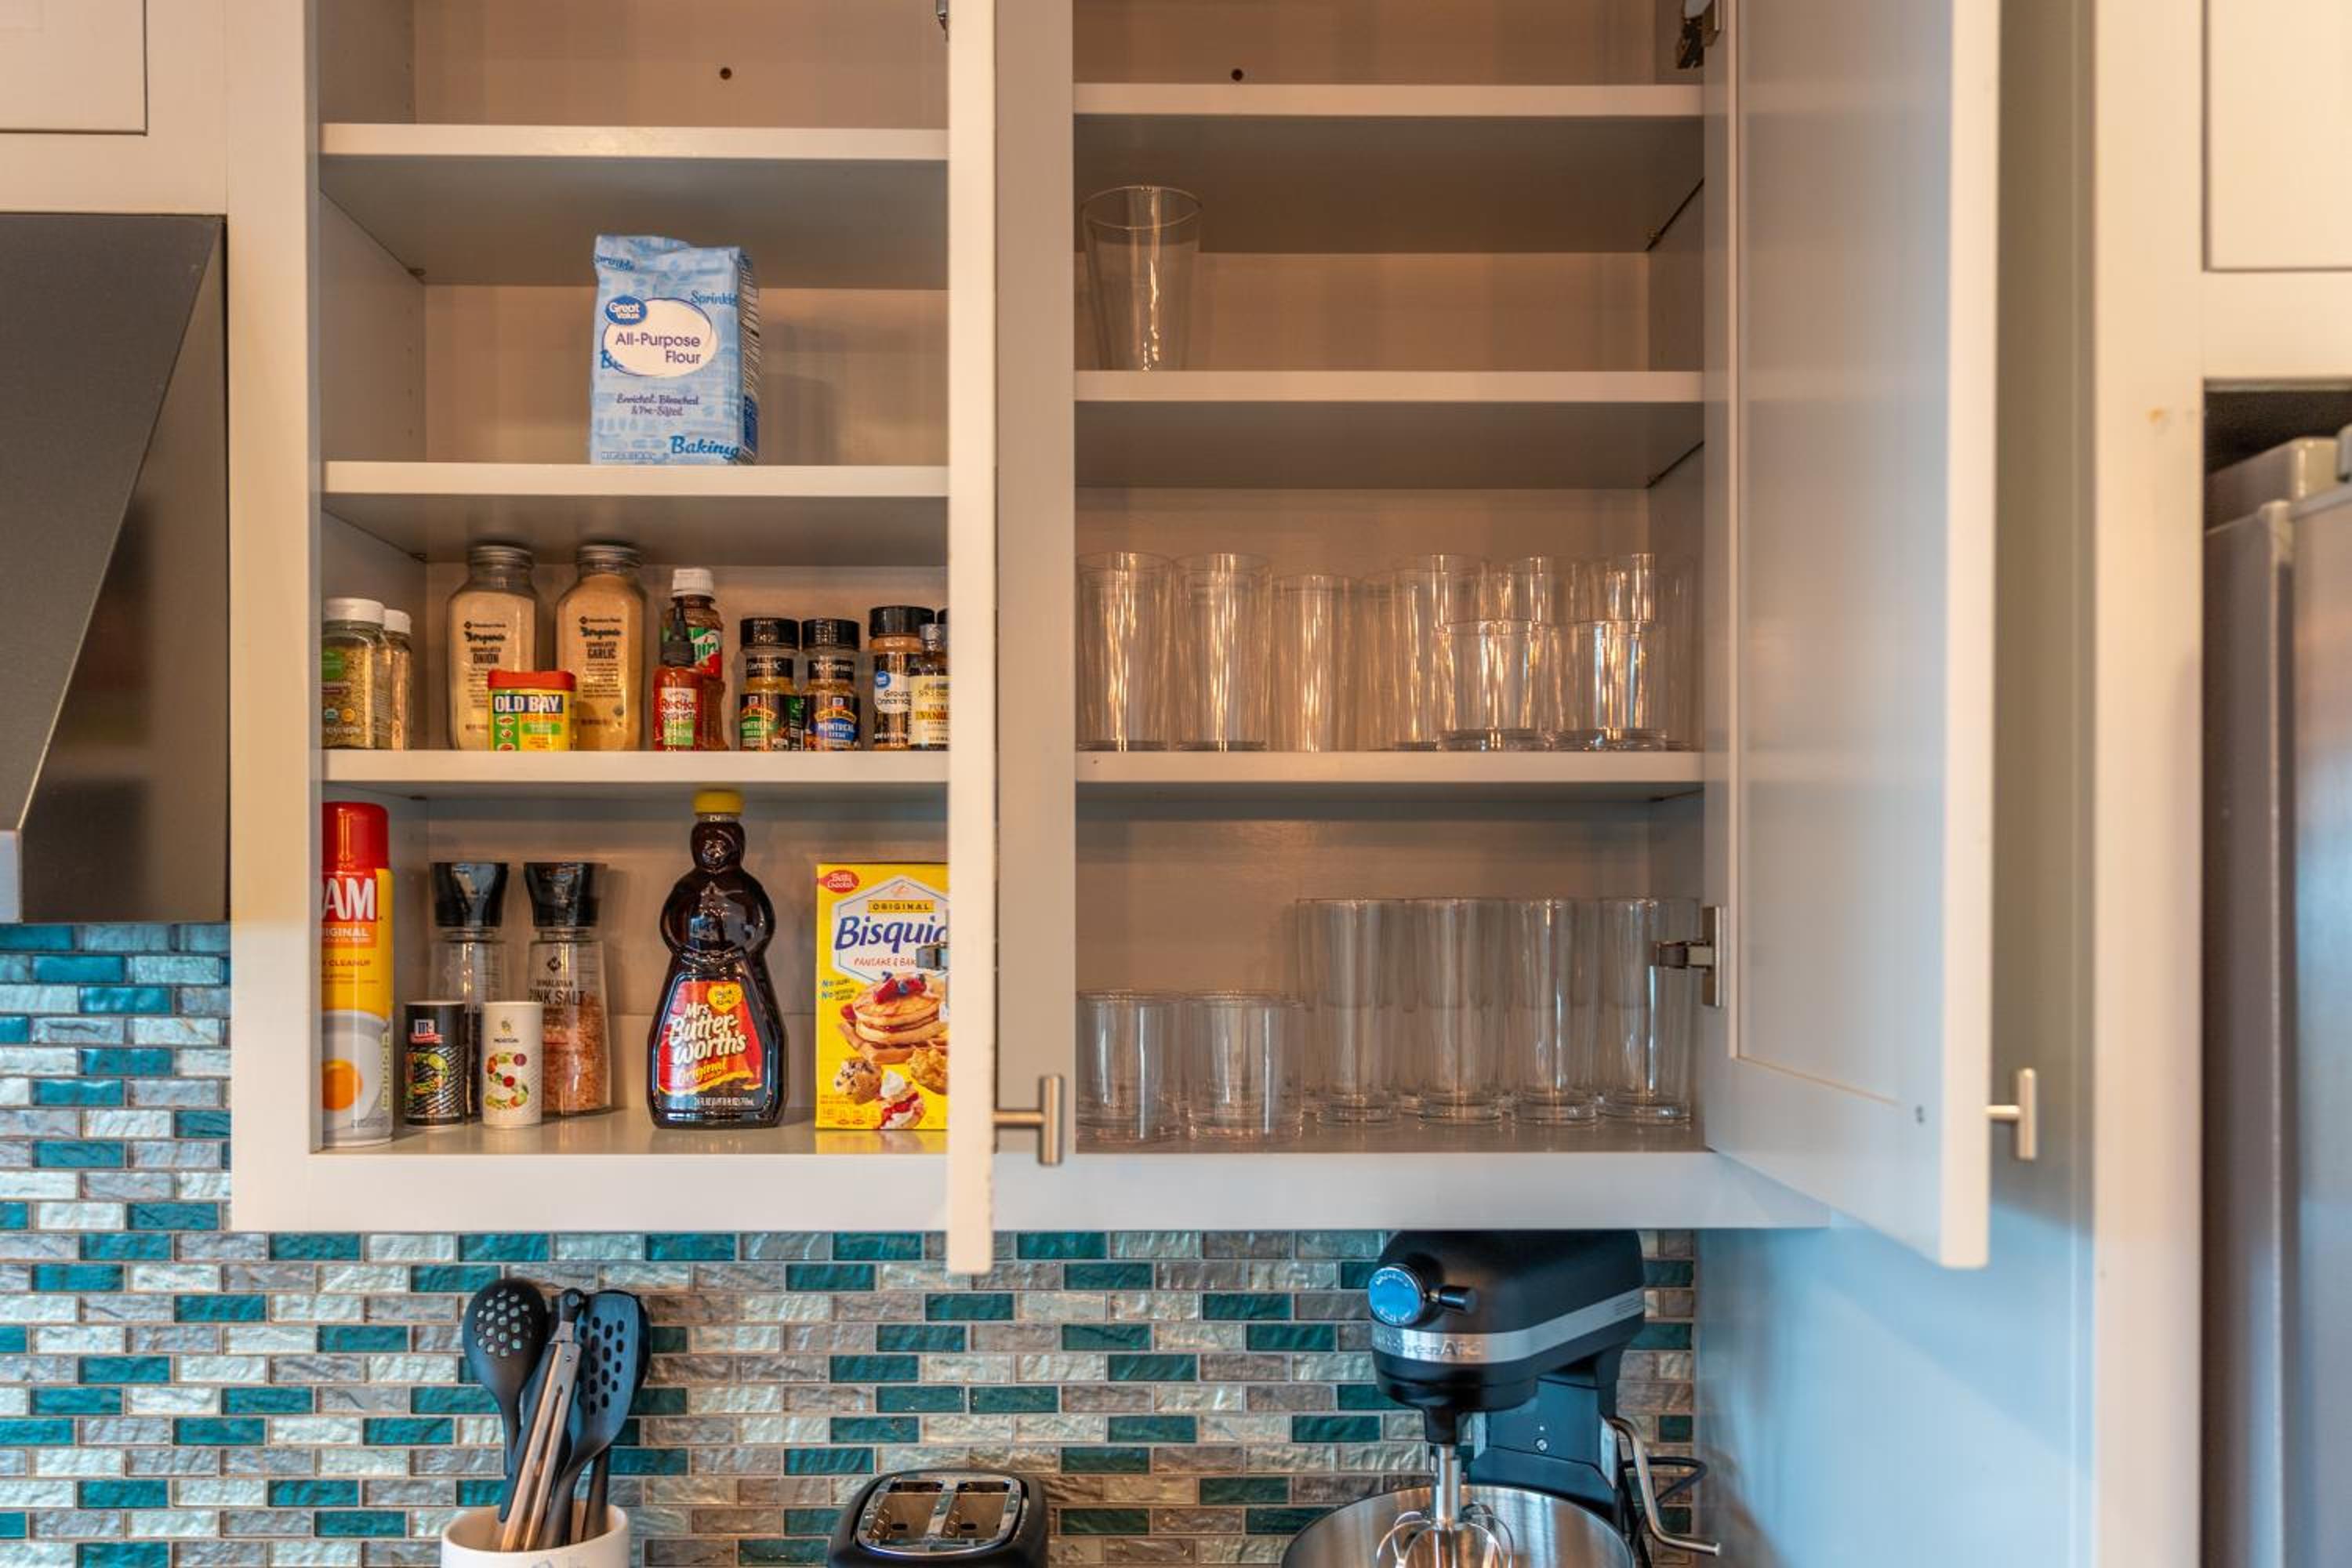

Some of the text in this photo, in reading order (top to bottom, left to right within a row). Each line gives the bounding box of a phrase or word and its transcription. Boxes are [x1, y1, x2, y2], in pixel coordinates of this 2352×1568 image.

[609, 302, 641, 314] Great
[615, 332, 700, 350] All-Purpose
[666, 351, 702, 365] Flour
[670, 434, 739, 459] Baking
[473, 652, 499, 665] ONION
[587, 648, 616, 659] GARLIC
[495, 695, 560, 713] OLD BAY
[321, 877, 376, 920] AM
[325, 927, 370, 937] IGINAL
[834, 915, 949, 954] Bisquic
[899, 957, 916, 967] BAK
[554, 990, 586, 1006] SALT
[669, 1014, 739, 1047] Butter-
[673, 1030, 747, 1065] worth's
